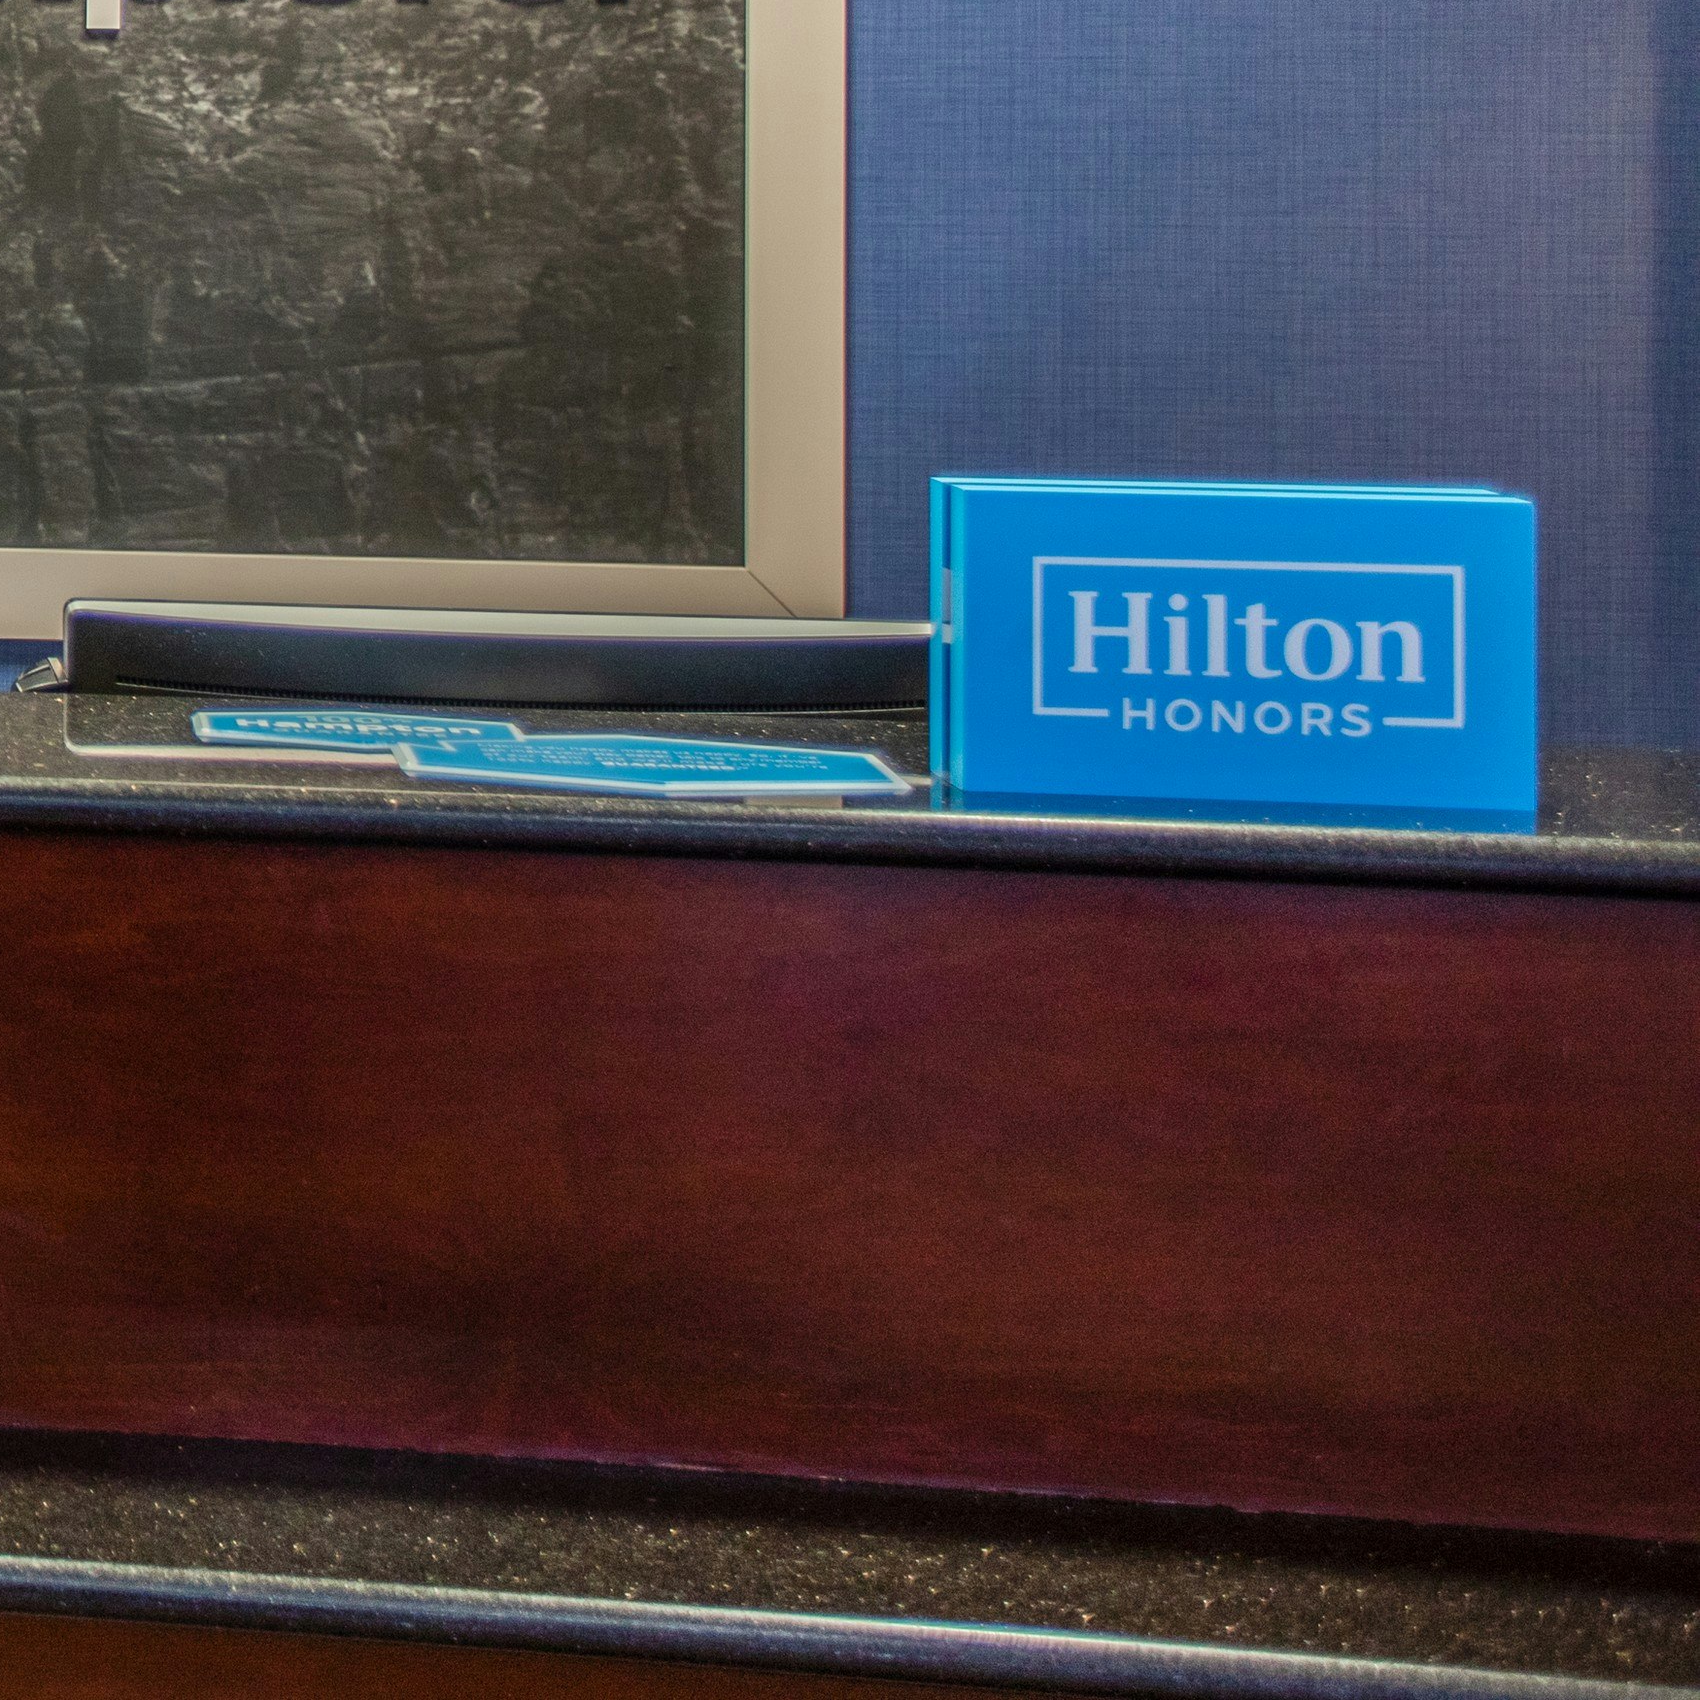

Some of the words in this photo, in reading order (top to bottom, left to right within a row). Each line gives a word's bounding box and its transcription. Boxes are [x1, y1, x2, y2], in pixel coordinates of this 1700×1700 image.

[1068, 589, 1426, 683] Hilton
[235, 718, 482, 735] Hampton
[1121, 697, 1372, 737] HONORS
